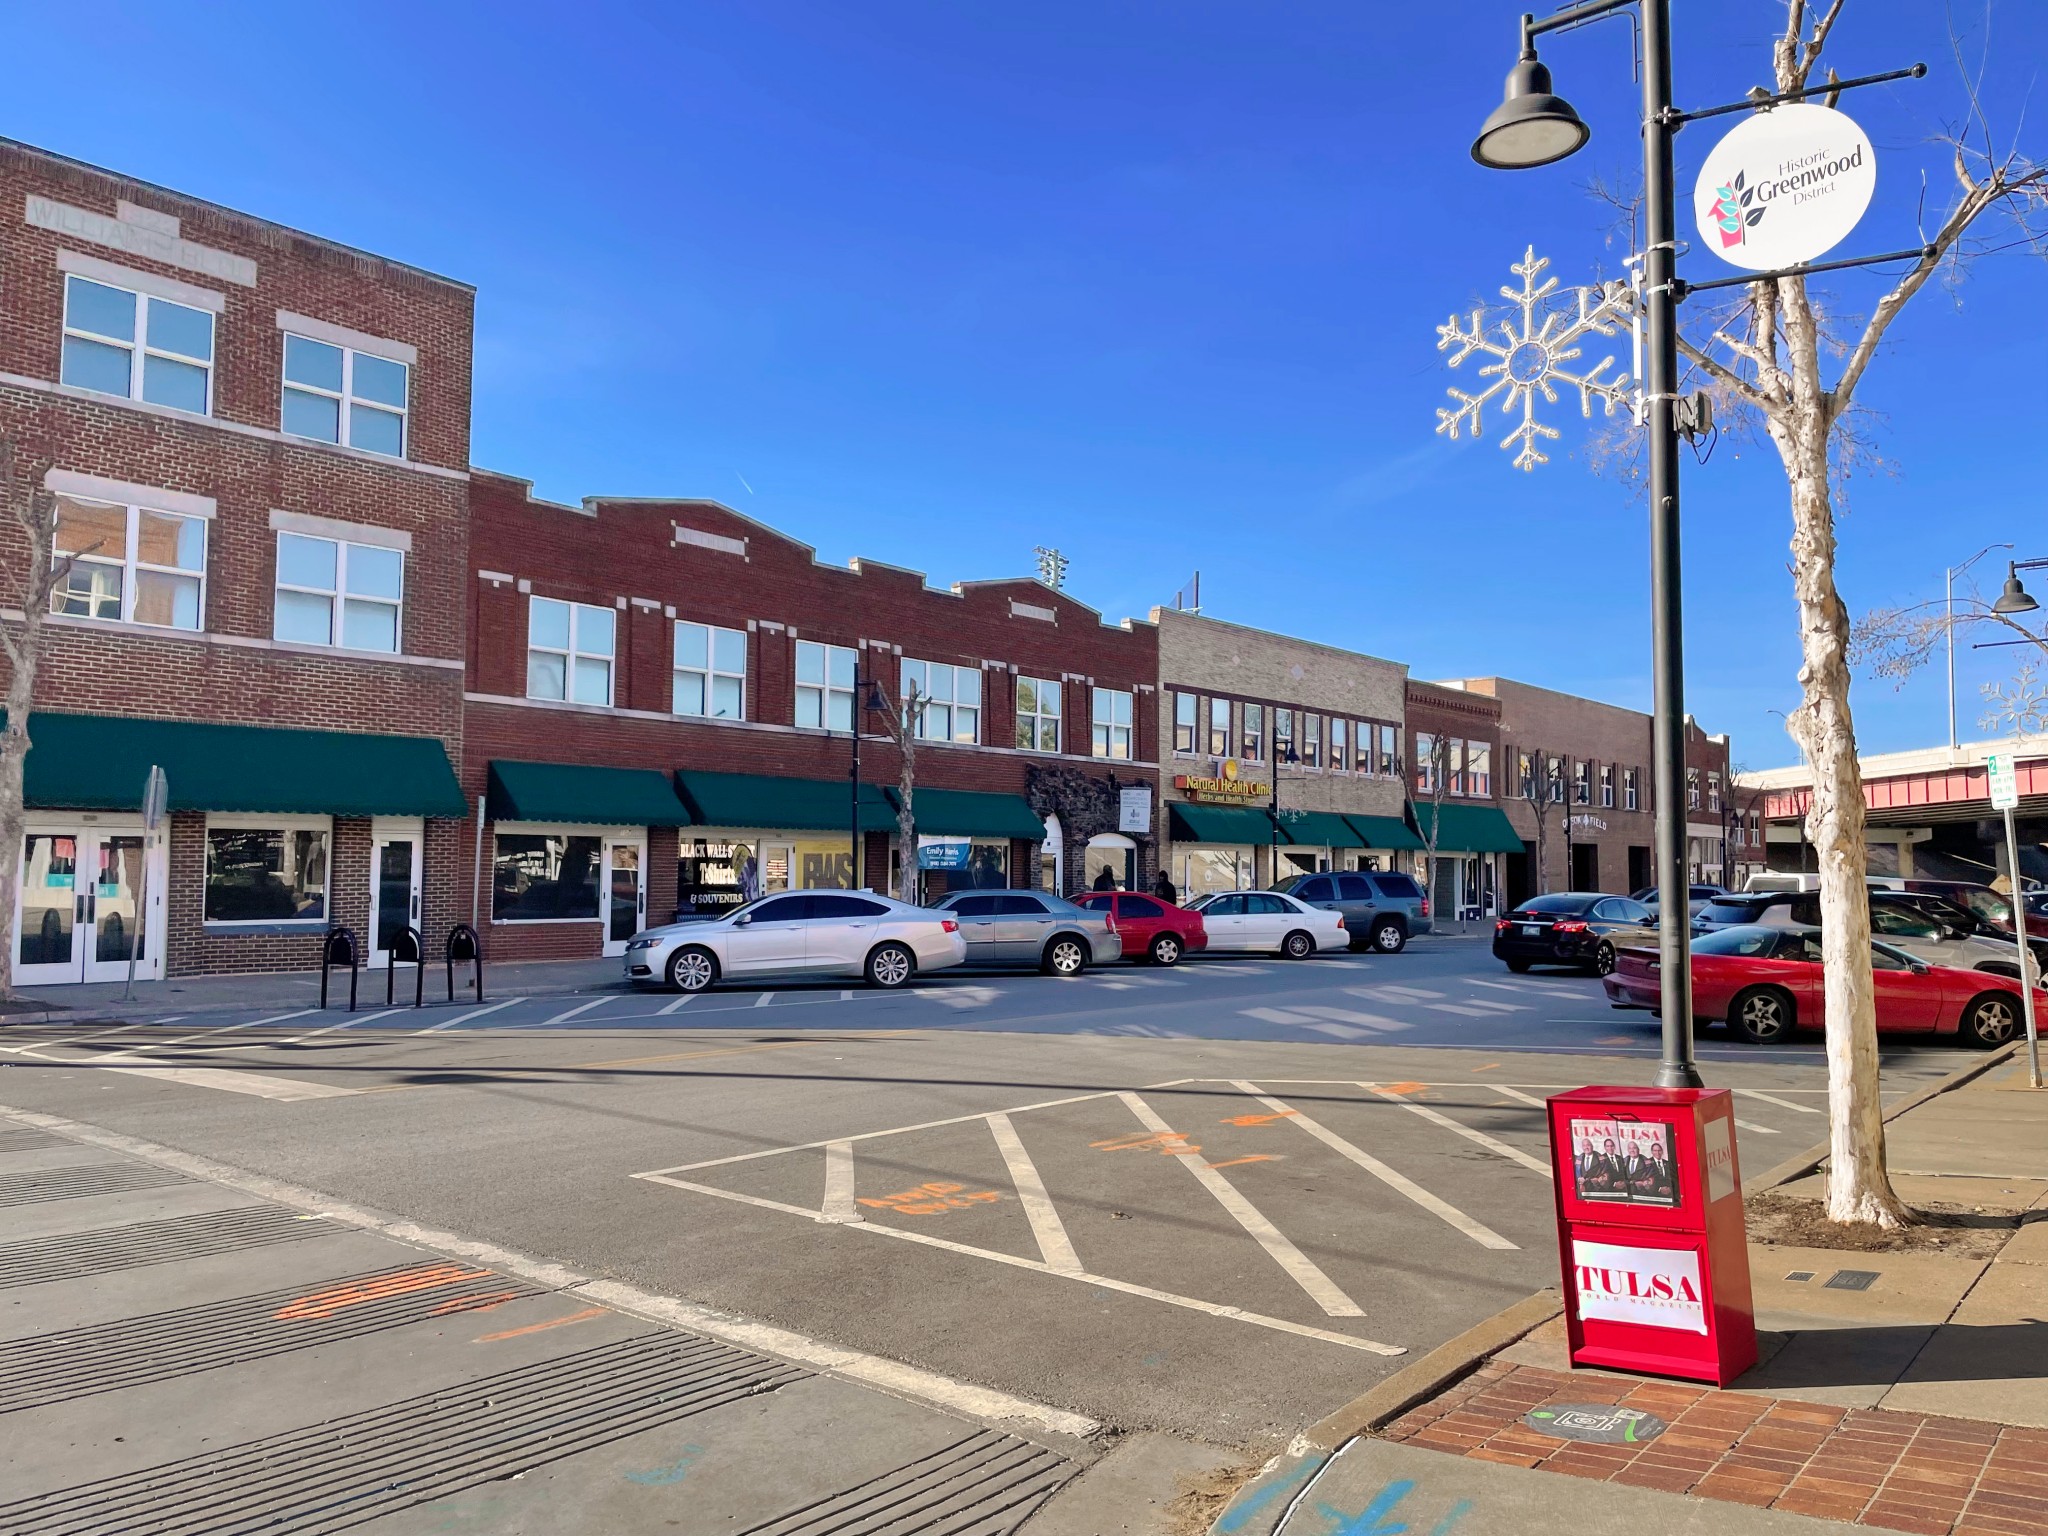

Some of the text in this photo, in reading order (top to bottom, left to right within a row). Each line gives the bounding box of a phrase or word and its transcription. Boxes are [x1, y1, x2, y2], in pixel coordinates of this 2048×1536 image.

[1779, 148, 1832, 176] Historic
[1757, 144, 1863, 202] Greenwood
[1794, 181, 1836, 205] District
[32, 199, 172, 259] WILLIAMS
[1989, 760, 1996, 773] 2
[1186, 775, 1272, 796] Natural Health Clinic
[1215, 793, 1225, 801] and
[1562, 815, 1607, 831] OEOK FIELD
[680, 844, 705, 858] BLACK
[706, 844, 728, 858] WALL
[926, 847, 944, 856] Emily
[690, 893, 744, 904] & SOUVENIRS
[1573, 1126, 1612, 1137] ULSA
[1619, 1128, 1660, 1141] ULSA
[1574, 1264, 1701, 1303] TULSA
[1630, 1298, 1702, 1311] MAGAZINE
